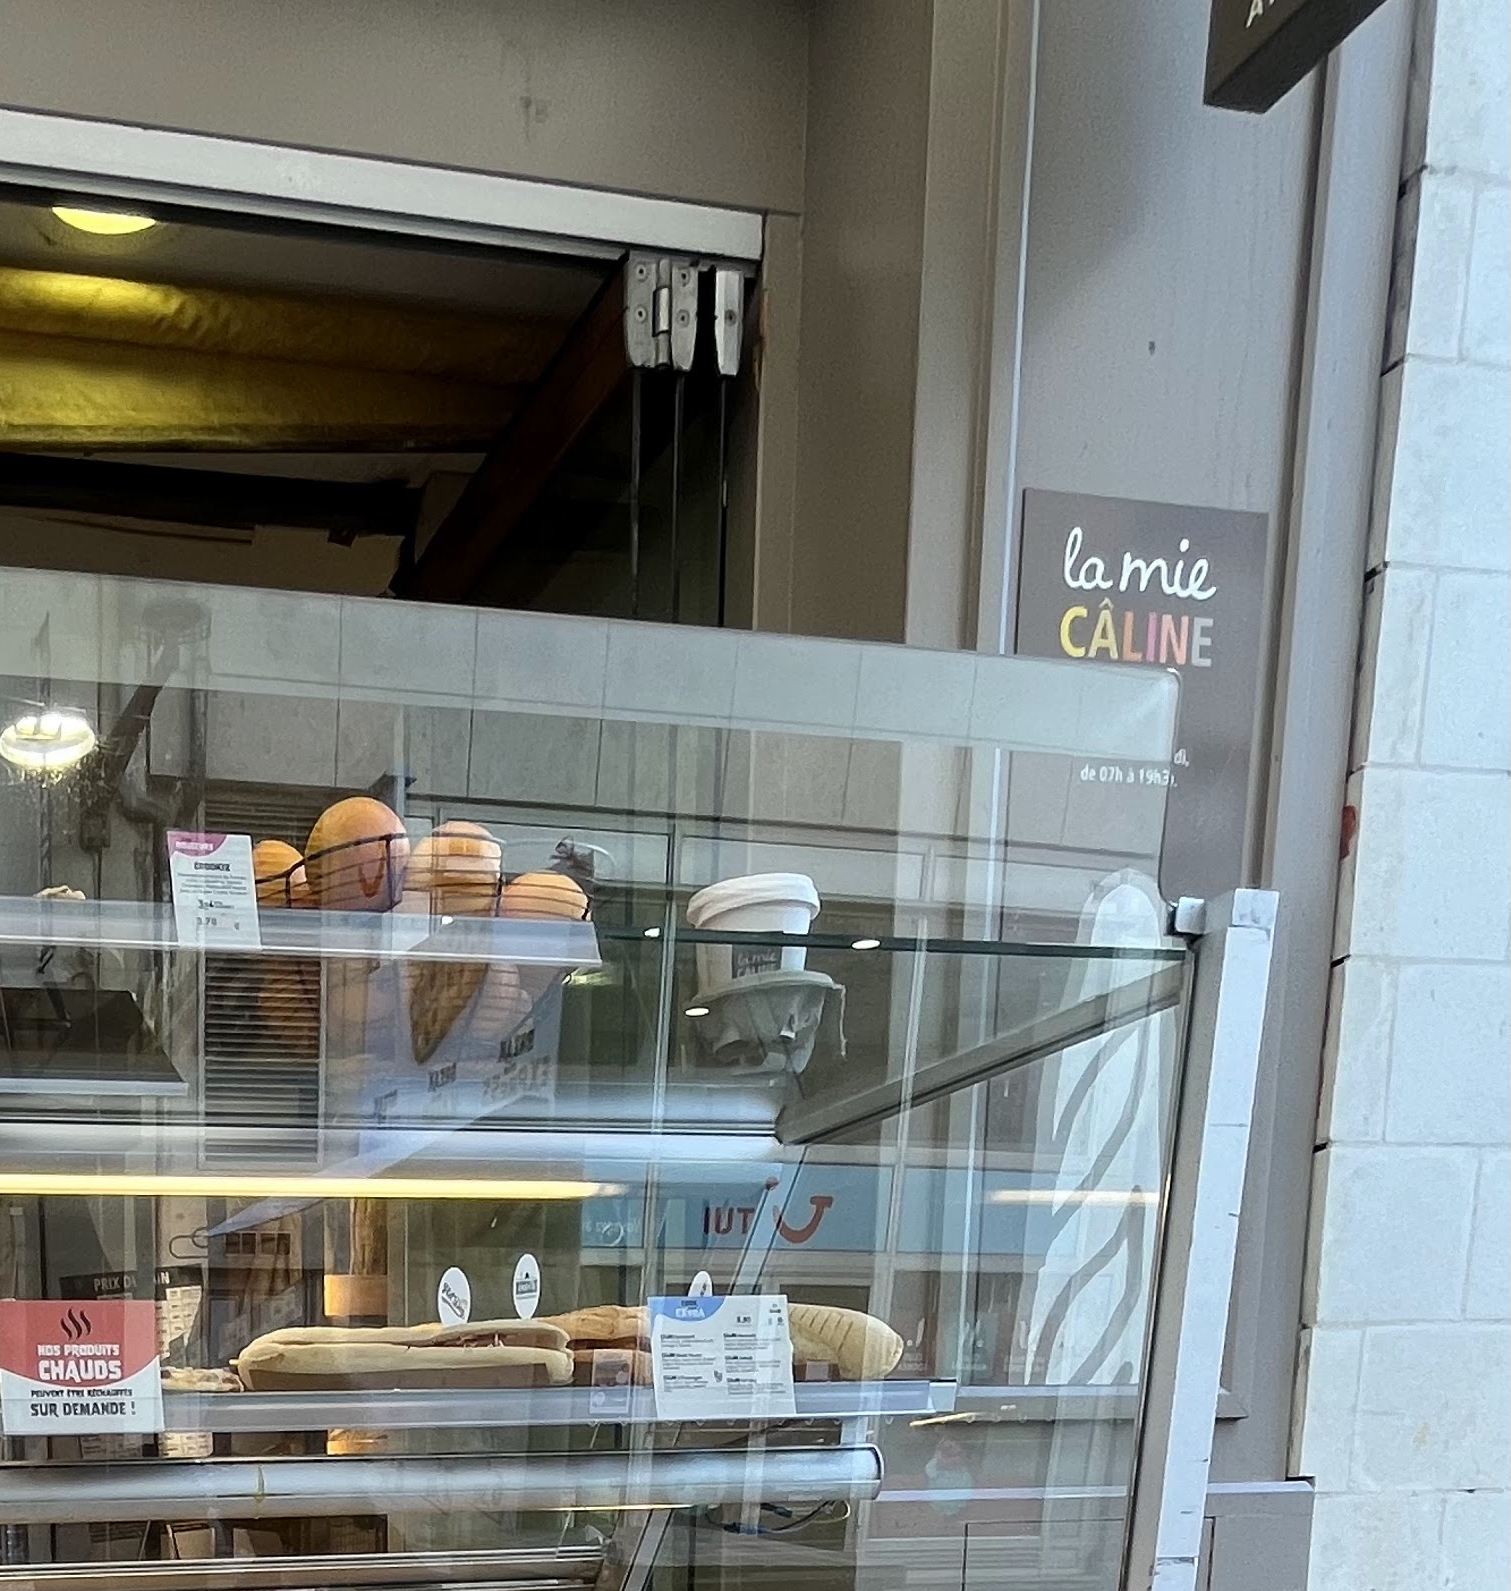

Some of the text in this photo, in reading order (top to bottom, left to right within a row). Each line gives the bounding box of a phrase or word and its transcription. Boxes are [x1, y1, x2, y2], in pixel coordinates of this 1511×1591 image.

[1063, 526, 1217, 600] la mie
[1059, 597, 1214, 667] CÂLINE
[1080, 764, 1096, 781] de
[93, 1277, 121, 1292] PRIX
[37, 1344, 120, 1357] NOS PRODUITS
[38, 1359, 122, 1383] CHAUDS
[31, 1389, 64, 1398] PEUVENT
[31, 1403, 59, 1417] SUR
[63, 1402, 127, 1415] DEMANDE
